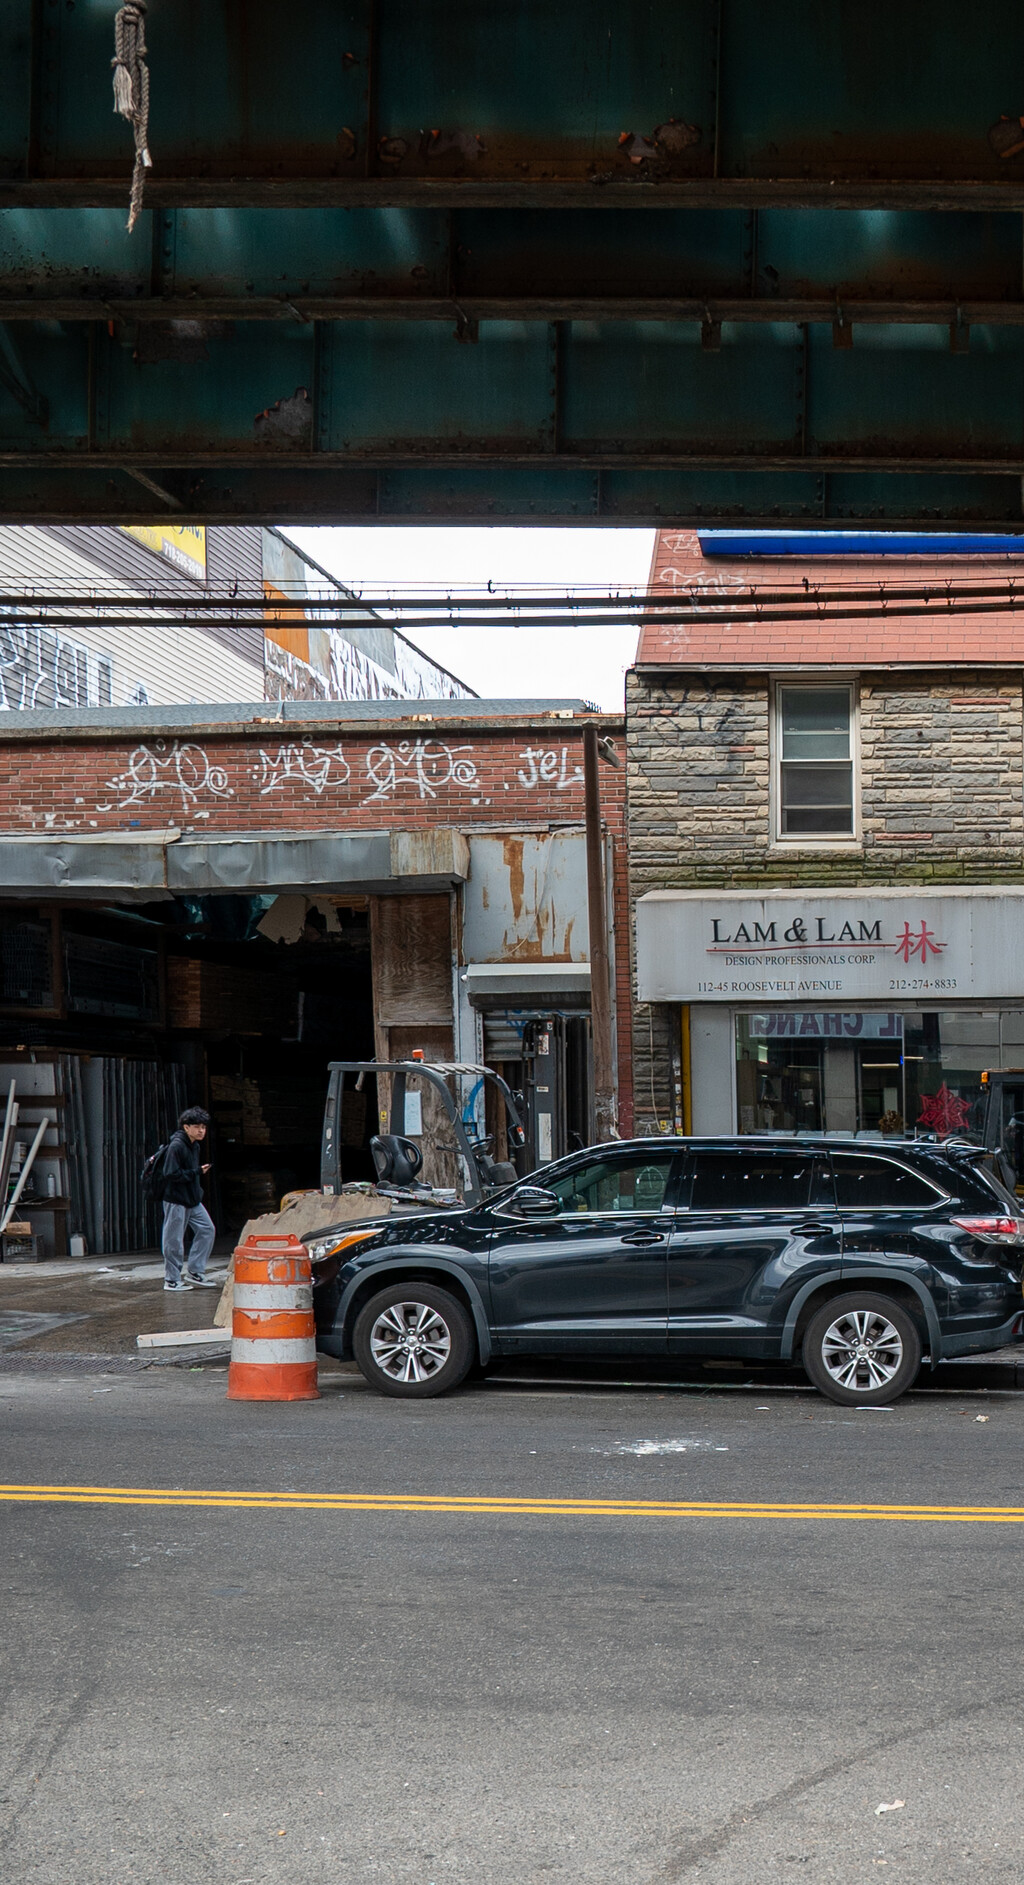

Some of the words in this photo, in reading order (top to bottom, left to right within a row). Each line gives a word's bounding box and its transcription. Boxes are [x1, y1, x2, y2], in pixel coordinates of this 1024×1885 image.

[710, 918, 778, 943] LAM
[784, 917, 808, 943] &
[814, 917, 883, 942] LAM
[895, 920, 943, 964] 林
[725, 955, 763, 967] DESIGN
[765, 954, 846, 966] PROFESSIONALS
[847, 954, 876, 965] CORP.
[697, 981, 729, 993] 112-45
[731, 981, 796, 992] ROOSEVELT
[797, 980, 843, 991] AVENUE
